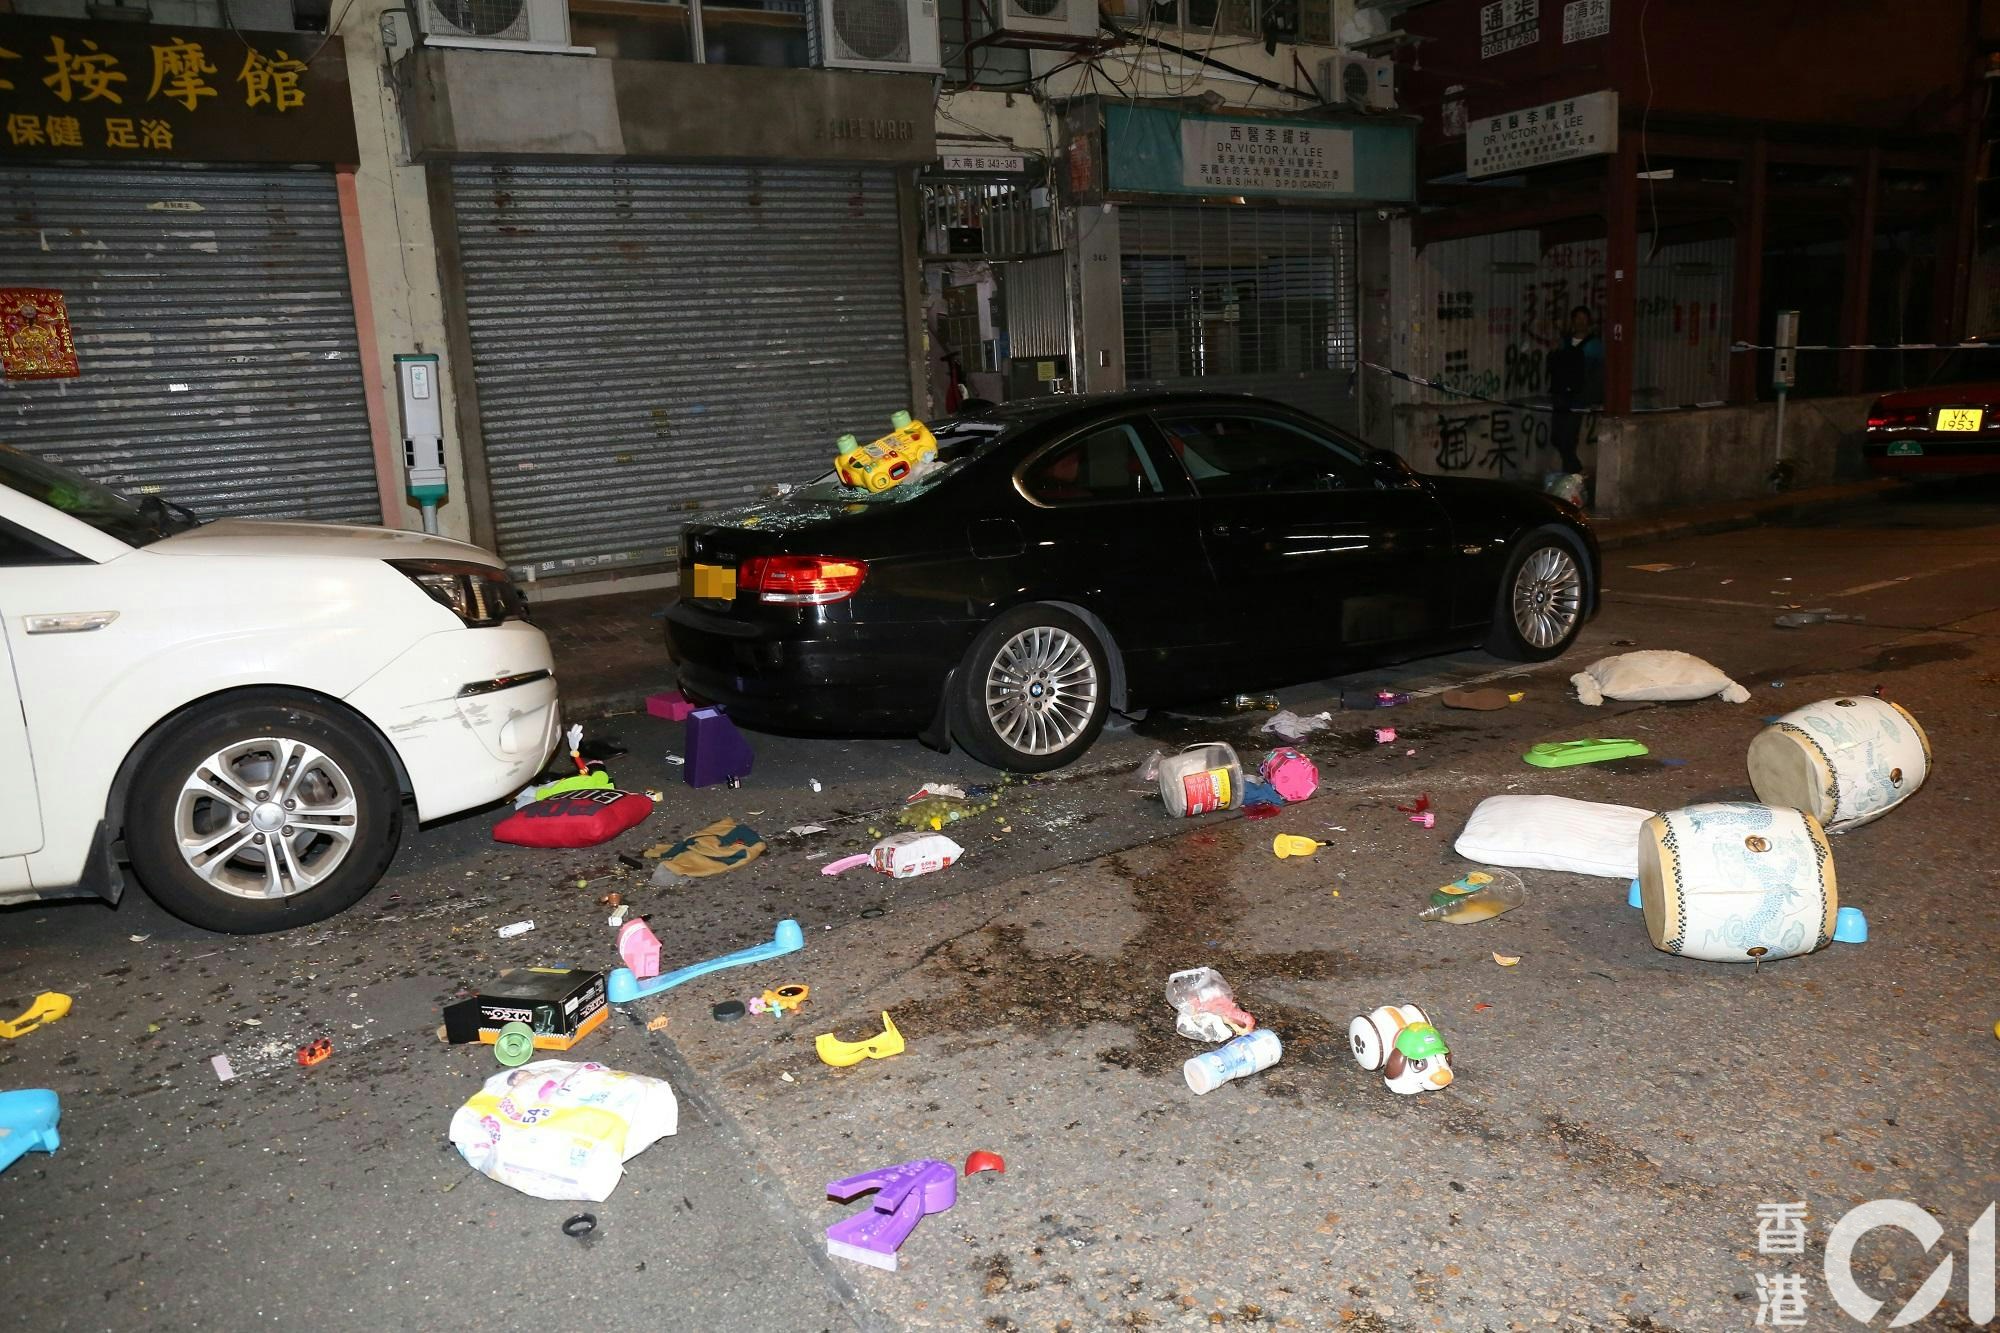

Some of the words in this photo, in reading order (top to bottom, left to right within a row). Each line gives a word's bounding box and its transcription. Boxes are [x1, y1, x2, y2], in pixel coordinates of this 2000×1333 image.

[1483, 31, 1537, 57] 90817280
[0, 35, 309, 112] 按摩館
[6, 112, 84, 148] 保健
[104, 117, 175, 151] 足浴
[1230, 126, 1311, 145] 西醫李耀球
[1502, 126, 1538, 142] VICTOR
[1564, 115, 1584, 129] LEE
[1304, 147, 1323, 158] LEE
[951, 157, 985, 170] 大南街
[988, 158, 1017, 169] 343-345
[1952, 410, 1969, 420] VK
[1942, 420, 1974, 431] 1953
[522, 1108, 542, 1124] 54
